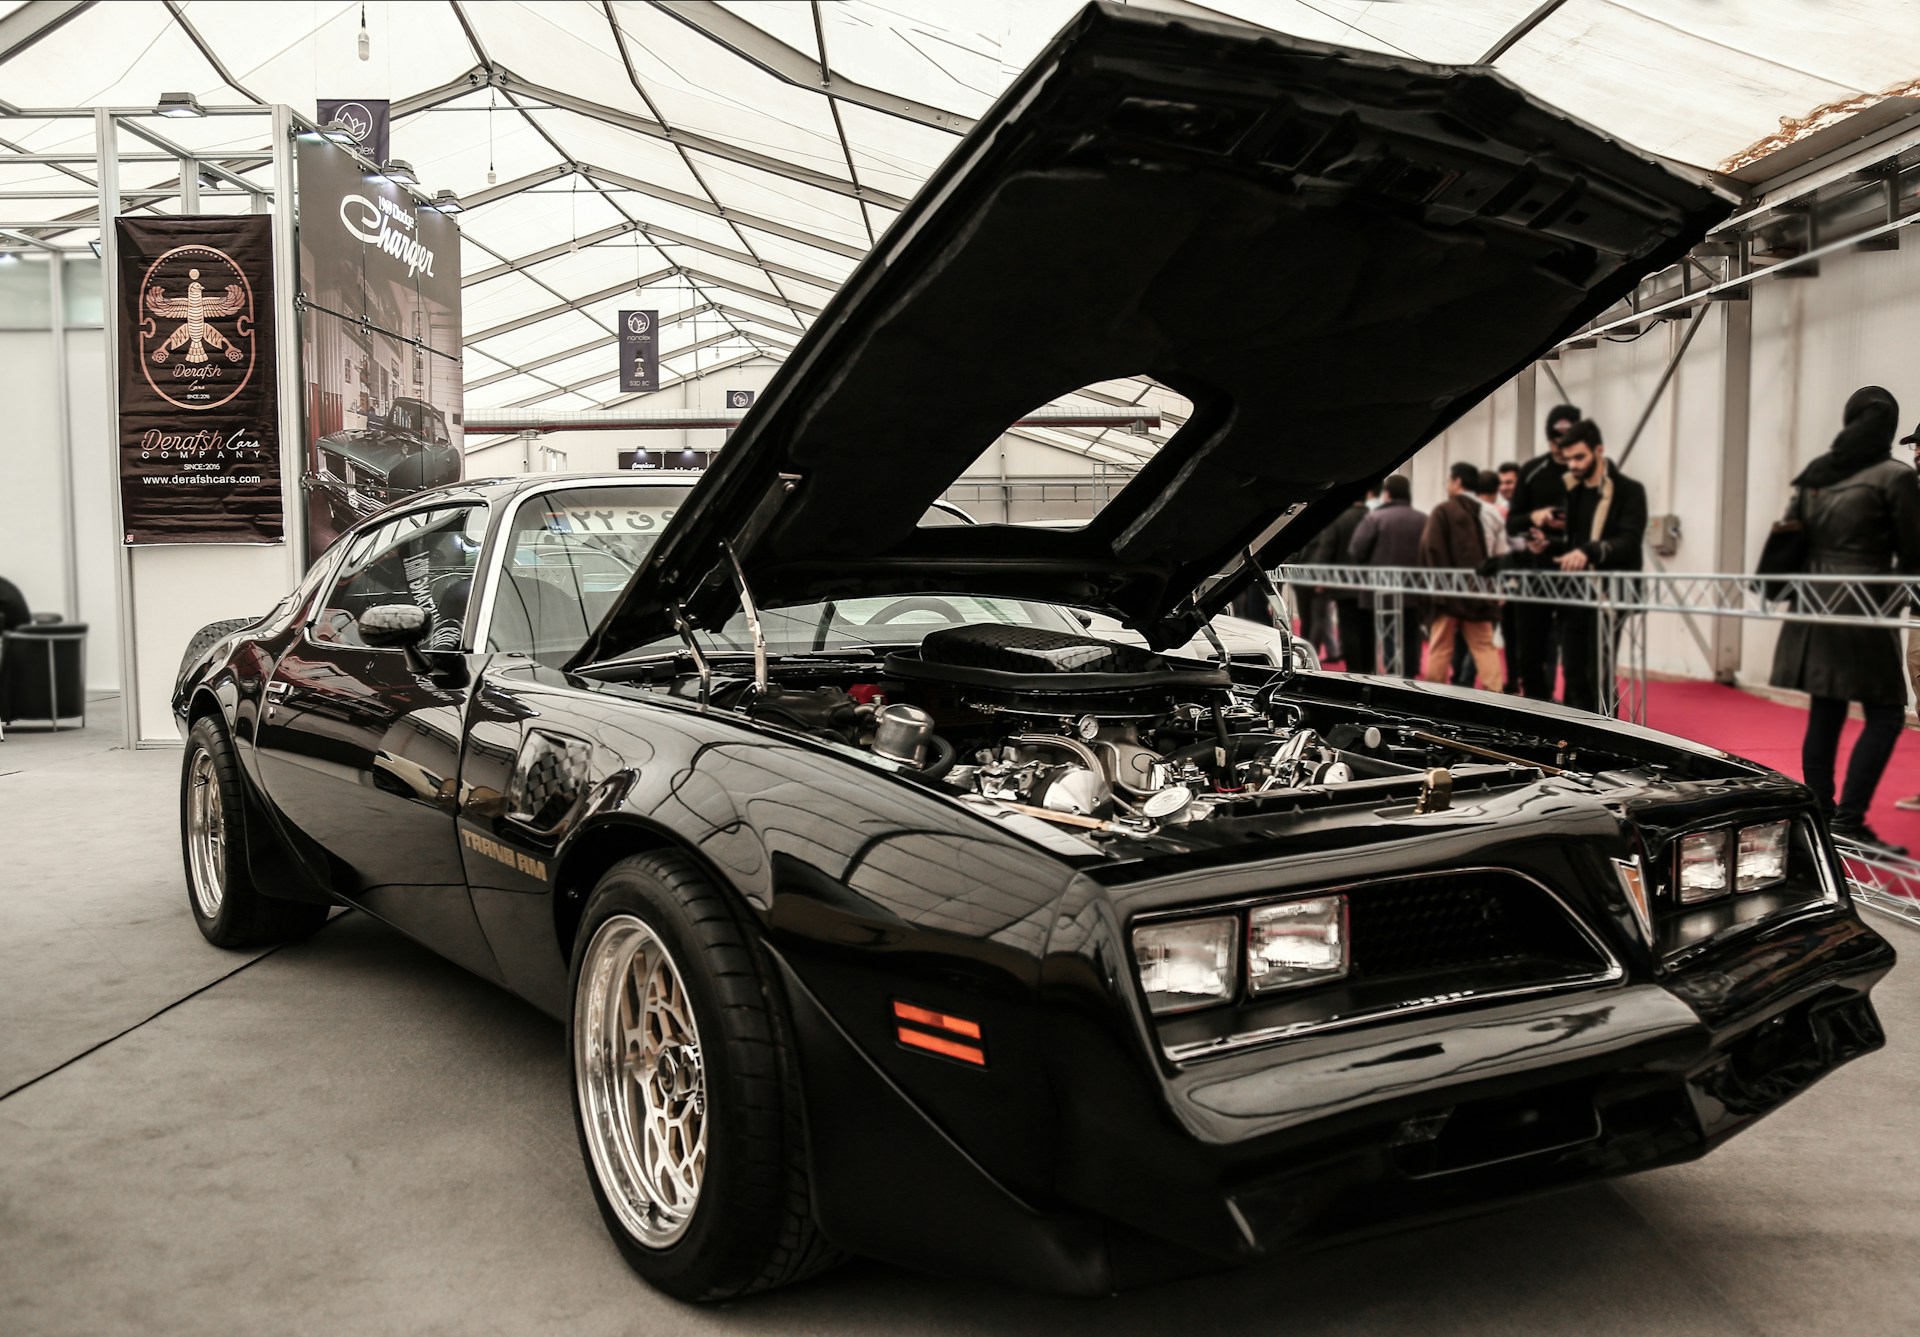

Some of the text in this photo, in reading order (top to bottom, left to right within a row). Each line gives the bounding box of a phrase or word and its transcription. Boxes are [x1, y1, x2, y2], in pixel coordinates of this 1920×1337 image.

[392, 203, 415, 231] Dodge
[339, 194, 435, 278] Charger
[172, 363, 223, 379] Derafsh
[141, 428, 261, 455] Derafsh Cars
[141, 450, 261, 459] COMPANY
[142, 474, 261, 485] www.derafshcars.com
[461, 828, 548, 882] TRANS AM
